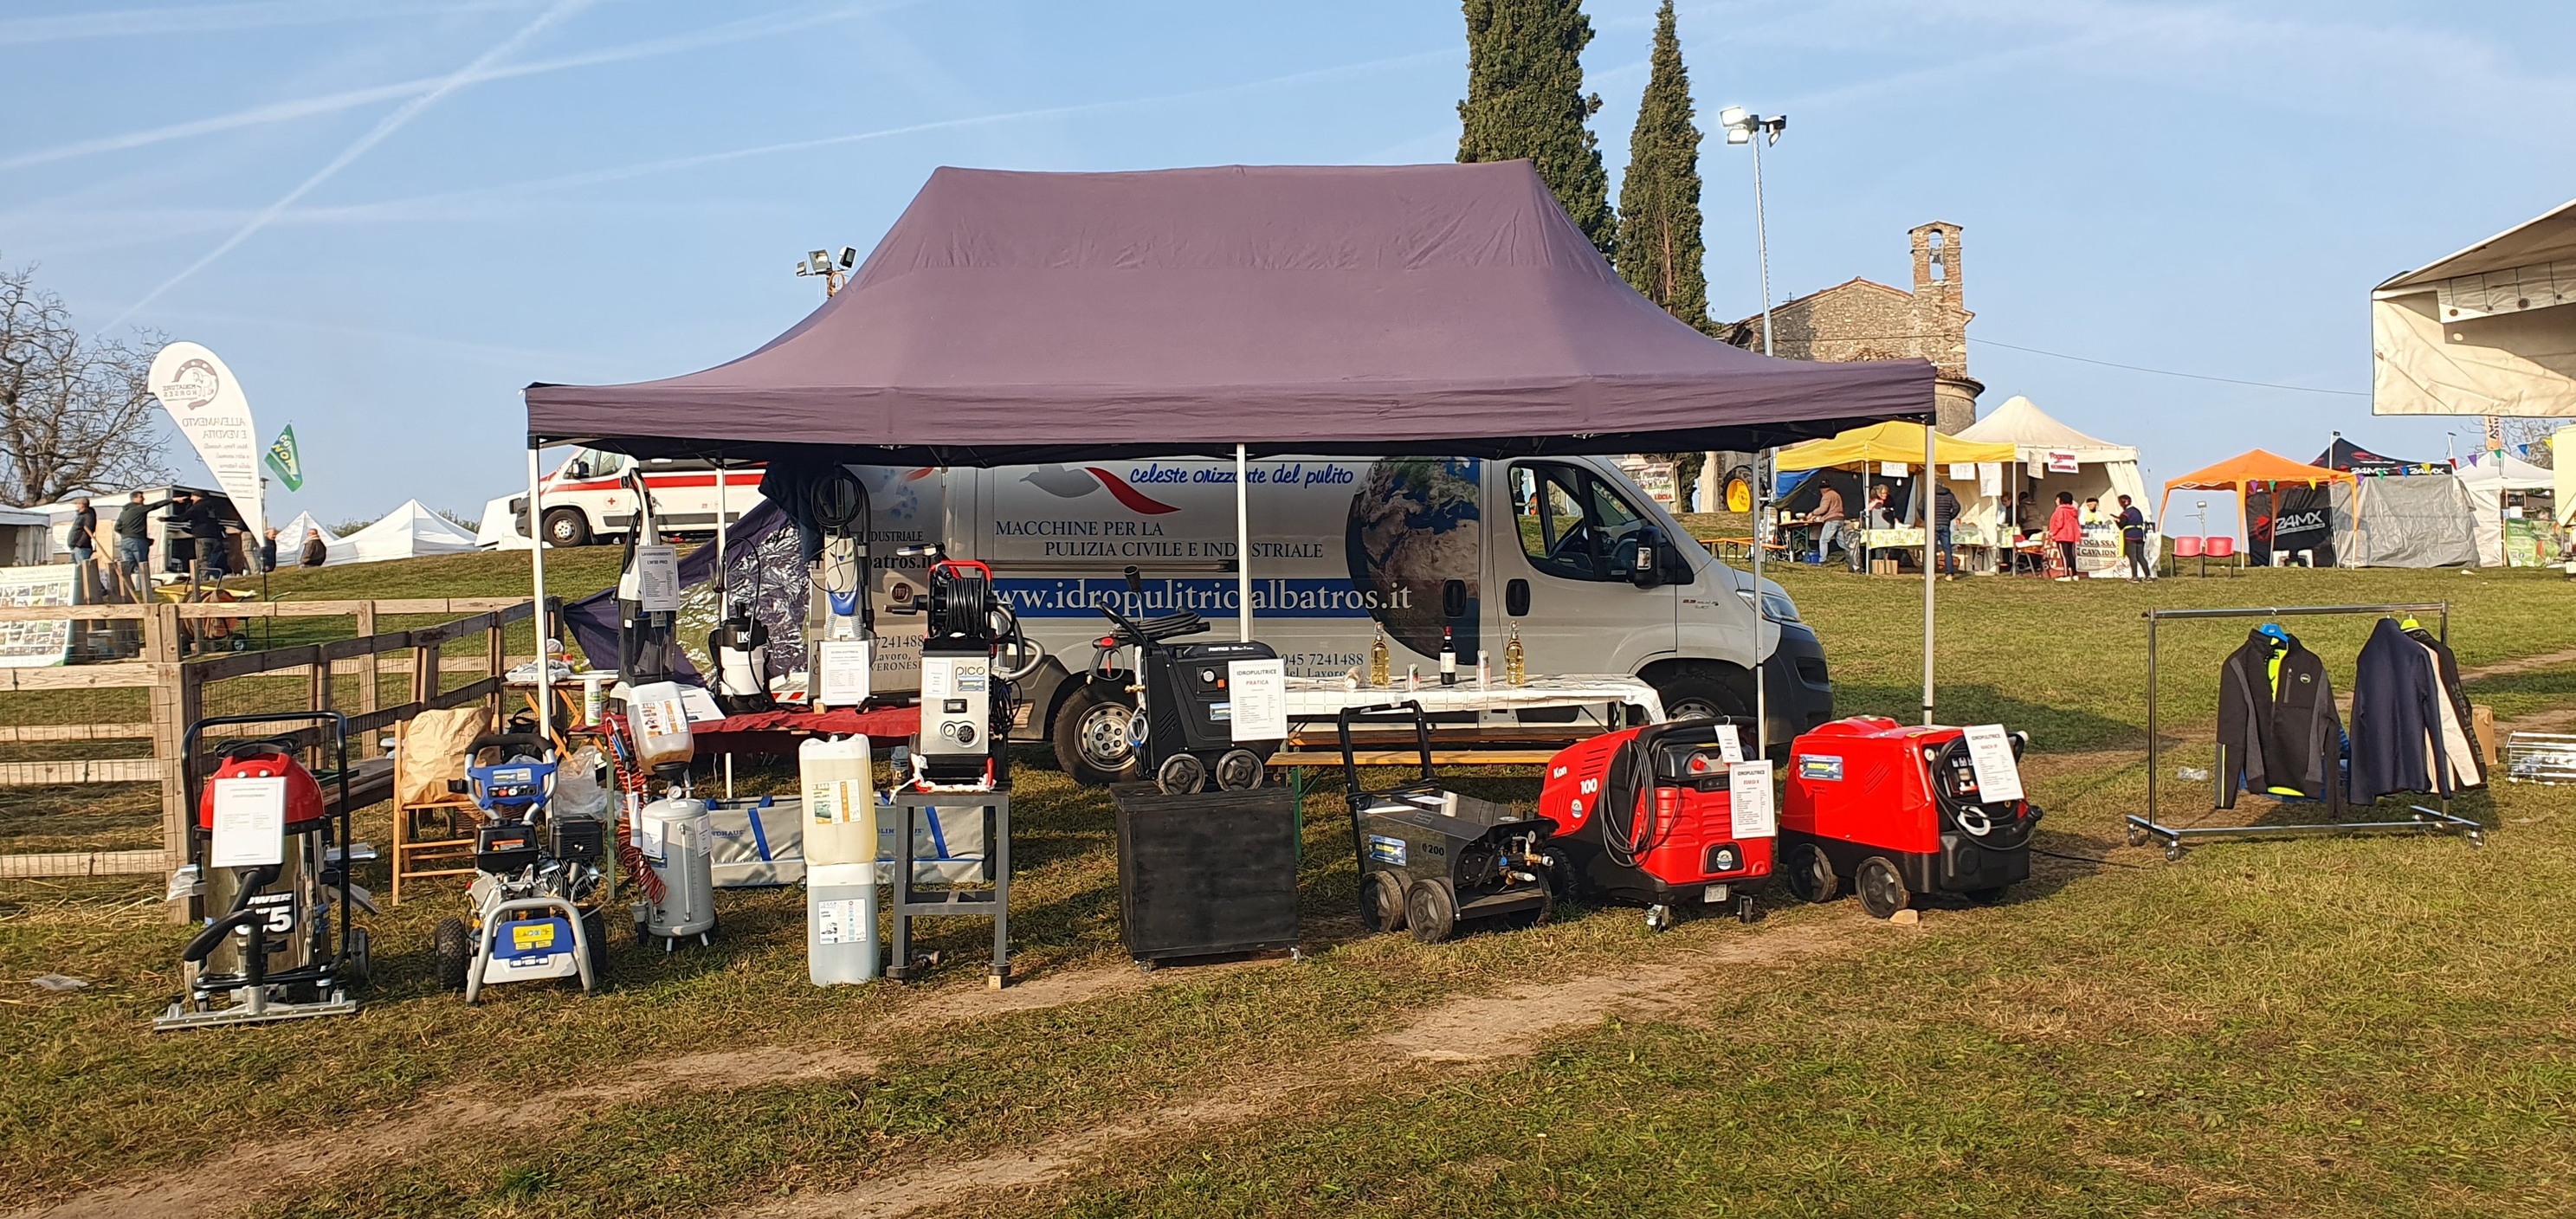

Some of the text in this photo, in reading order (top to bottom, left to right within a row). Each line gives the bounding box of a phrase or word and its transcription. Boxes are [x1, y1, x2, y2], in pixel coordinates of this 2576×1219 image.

[1130, 463, 1188, 484] celeste
[1272, 464, 1301, 484] del
[1304, 463, 1354, 489] pulito
[996, 520, 1164, 536] MACCHINE PER LA
[871, 531, 924, 542] DUSTRIALE
[1045, 541, 1323, 558] PULIZIA CIVILE E INDSTRIALE
[873, 554, 933, 569] atros.it
[993, 579, 1413, 617] ww.idropulitricalbatros.it
[875, 653, 912, 661] avoro,
[1282, 653, 1364, 666] 045 7241488
[1579, 777, 1598, 796] 100
[1428, 844, 1445, 856] 200
[248, 893, 293, 906] WER
